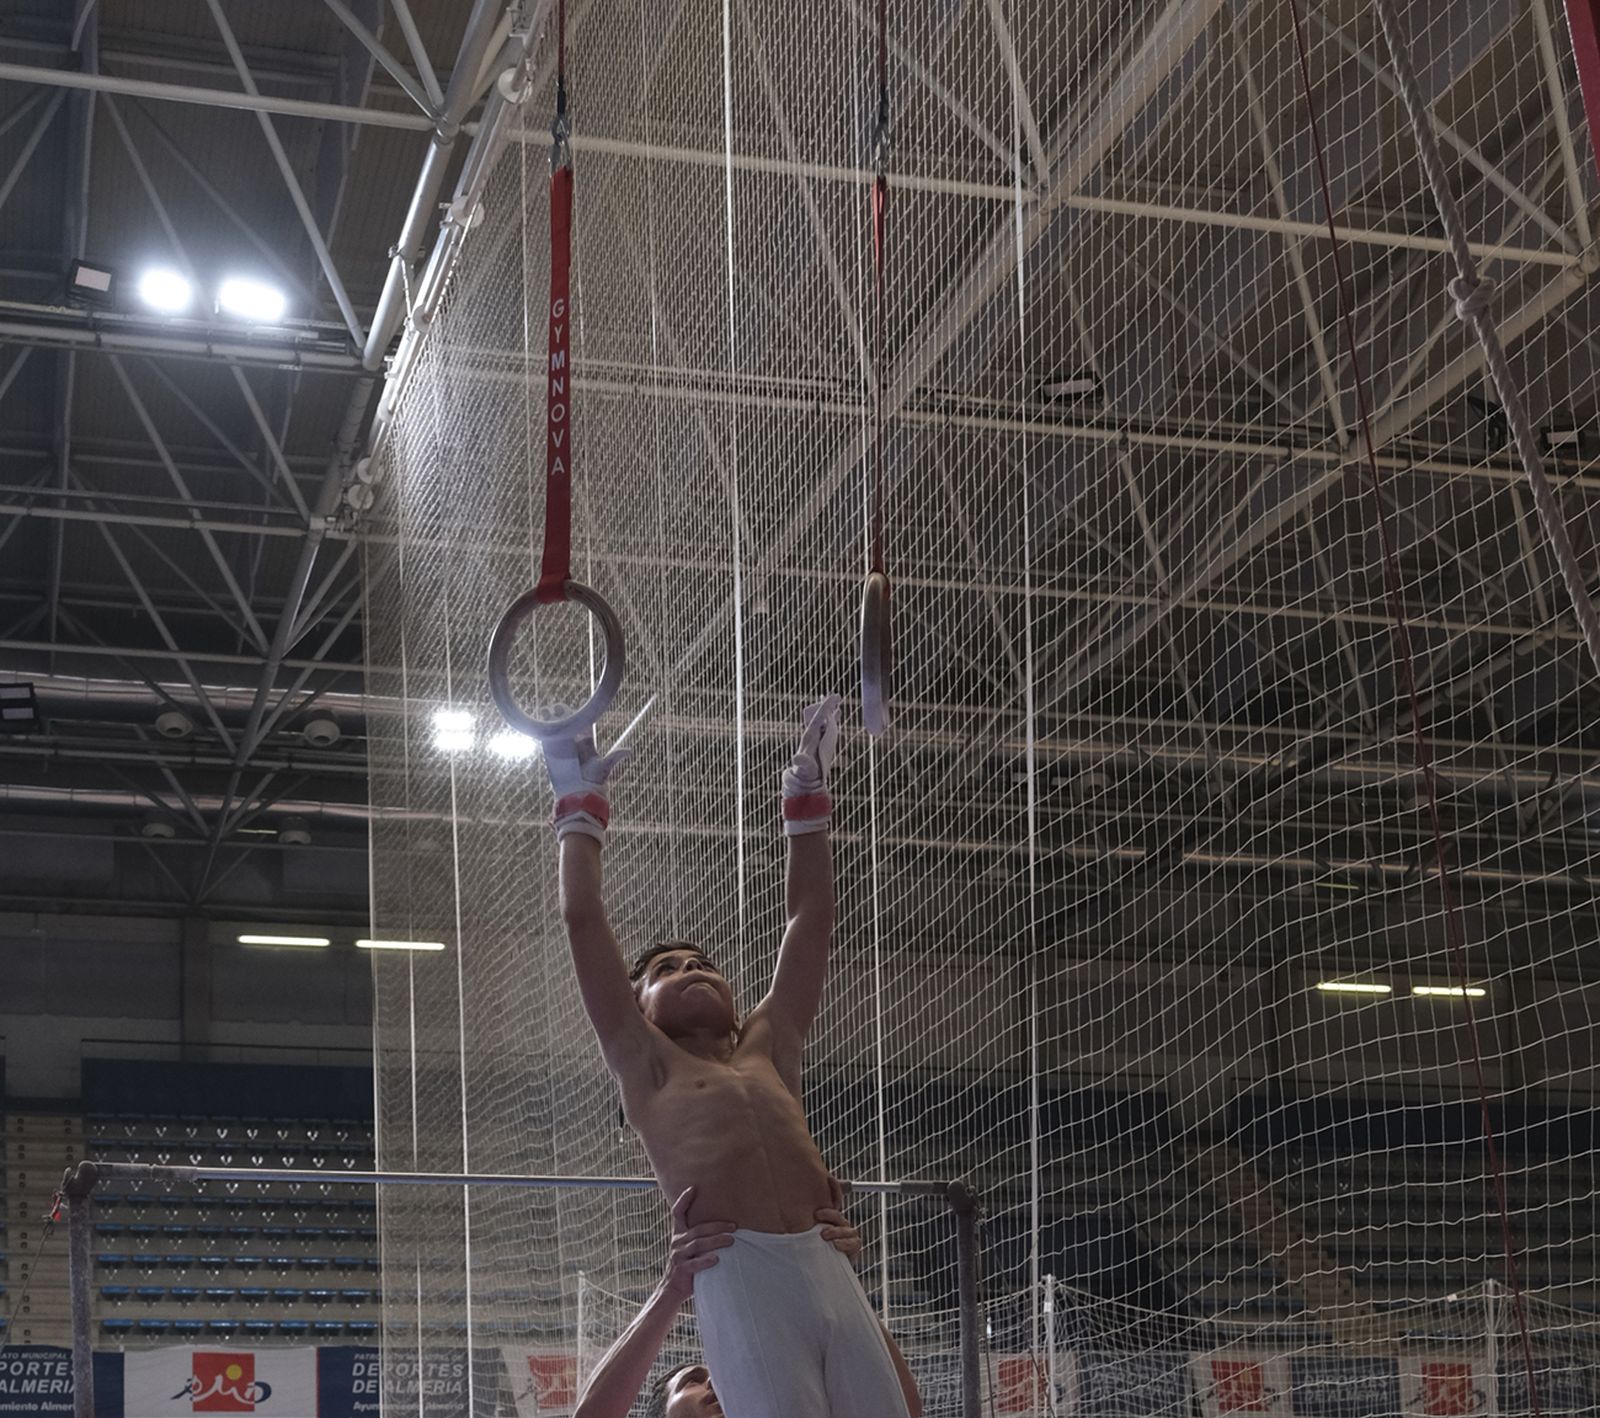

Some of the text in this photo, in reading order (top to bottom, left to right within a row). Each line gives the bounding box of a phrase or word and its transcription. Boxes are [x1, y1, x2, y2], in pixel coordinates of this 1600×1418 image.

[551, 298, 566, 476] GYMNOVA
[0, 1361, 74, 1376] PORTE
[352, 1379, 379, 1394] DE
[41, 1401, 75, 1411] Almer
